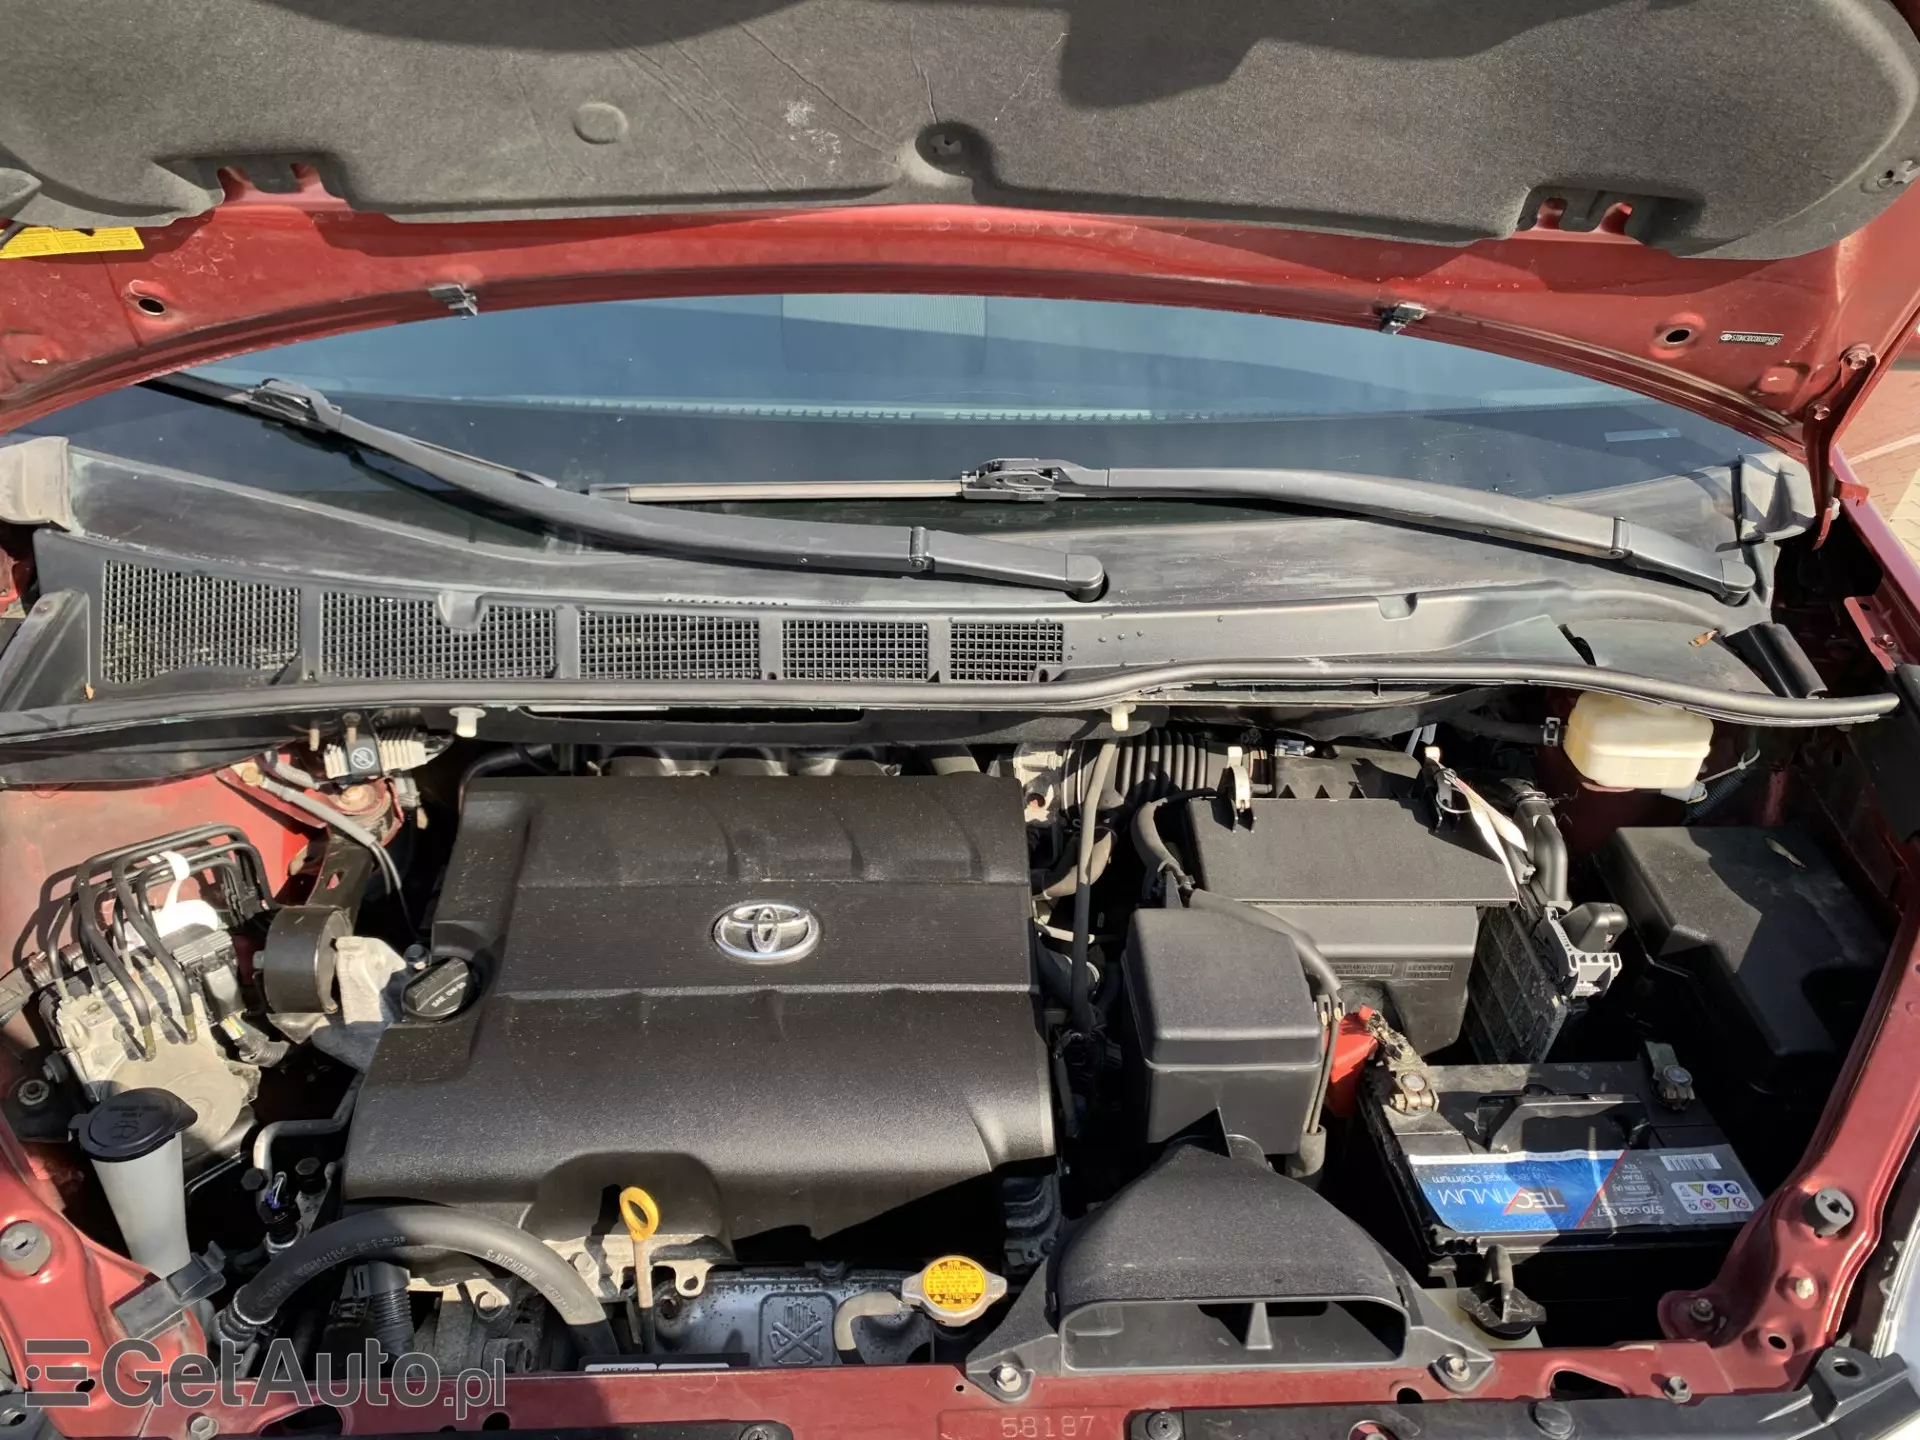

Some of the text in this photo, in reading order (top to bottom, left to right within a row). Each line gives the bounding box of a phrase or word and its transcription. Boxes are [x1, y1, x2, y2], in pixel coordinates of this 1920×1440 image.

[1431, 1174, 1483, 1186] Optimum
[1619, 1206, 1642, 1215] 029
[1642, 1204, 1665, 1215] 570
[1001, 1415, 1095, 1438] 58187
